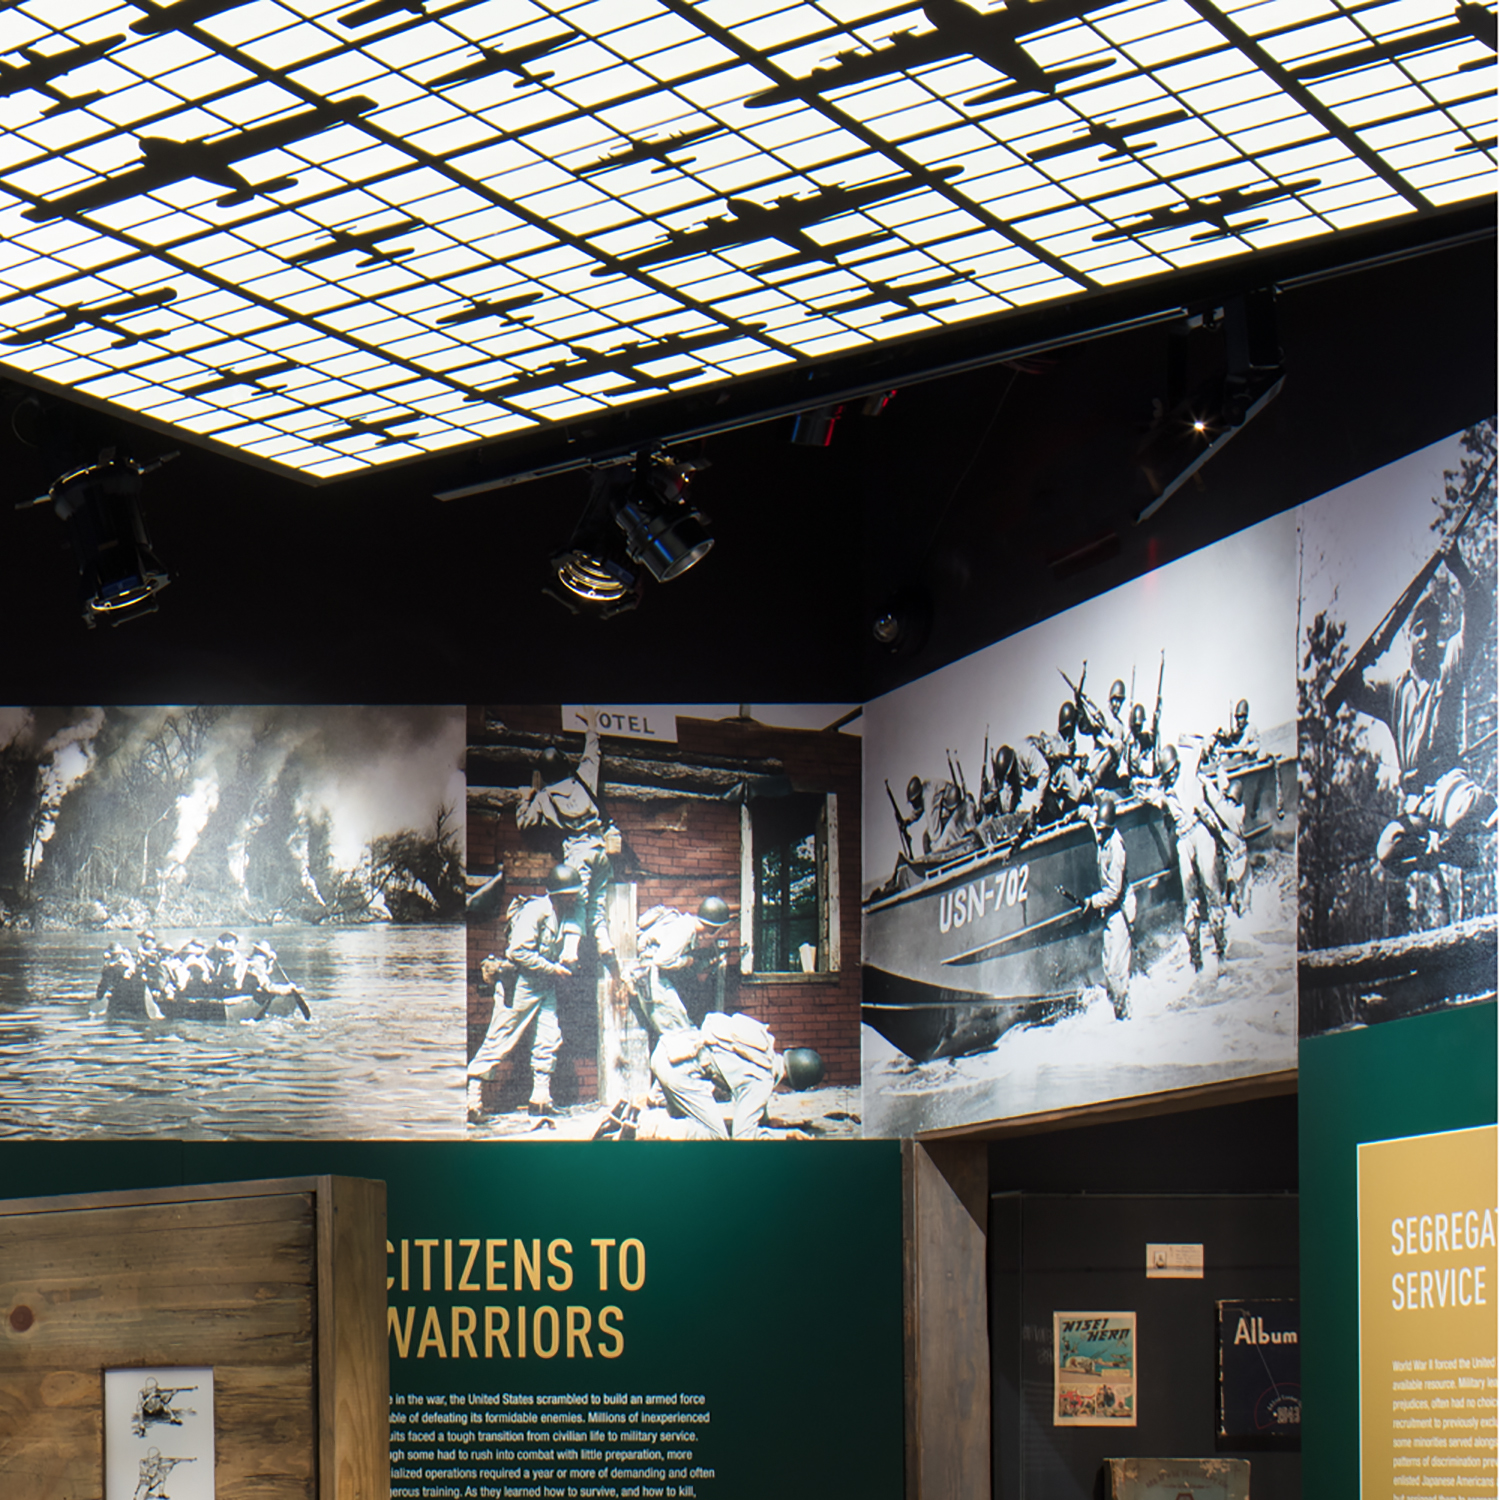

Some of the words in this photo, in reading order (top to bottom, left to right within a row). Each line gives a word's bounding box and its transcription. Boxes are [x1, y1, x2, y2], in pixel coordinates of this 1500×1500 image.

[599, 712, 656, 735] OTEL
[939, 862, 1030, 934] USN-702
[1391, 1208, 1498, 1257] SEGREGA
[591, 1237, 647, 1292] TO
[1391, 1265, 1487, 1312] SERVICE
[1062, 1317, 1110, 1333] NISEI
[1233, 1316, 1299, 1345] Album
[395, 1394, 405, 1404] in
[407, 1394, 423, 1405] the
[426, 1395, 446, 1406] war,
[449, 1394, 465, 1405] the
[467, 1393, 500, 1405] United
[502, 1392, 534, 1405] States
[536, 1393, 588, 1404] scrambled
[590, 1394, 601, 1404] to
[602, 1393, 628, 1404] build
[630, 1395, 643, 1404] an
[645, 1393, 677, 1404] armed
[679, 1392, 705, 1404] force
[408, 1411, 419, 1423] of
[421, 1412, 468, 1425] defeating
[470, 1412, 482, 1423] its
[485, 1412, 538, 1423] formidable
[540, 1412, 586, 1423] enemies.
[587, 1411, 626, 1423] Millions
[628, 1411, 638, 1423] of
[640, 1412, 710, 1424] inexperienced
[407, 1430, 435, 1442] faced
[437, 1432, 444, 1442] a
[446, 1430, 475, 1444] tough
[477, 1431, 524, 1442] transition
[526, 1430, 550, 1442] from
[552, 1430, 587, 1442] civilian
[589, 1430, 605, 1442] life
[607, 1430, 618, 1442] to
[620, 1430, 657, 1444] military
[659, 1430, 697, 1441] service.
